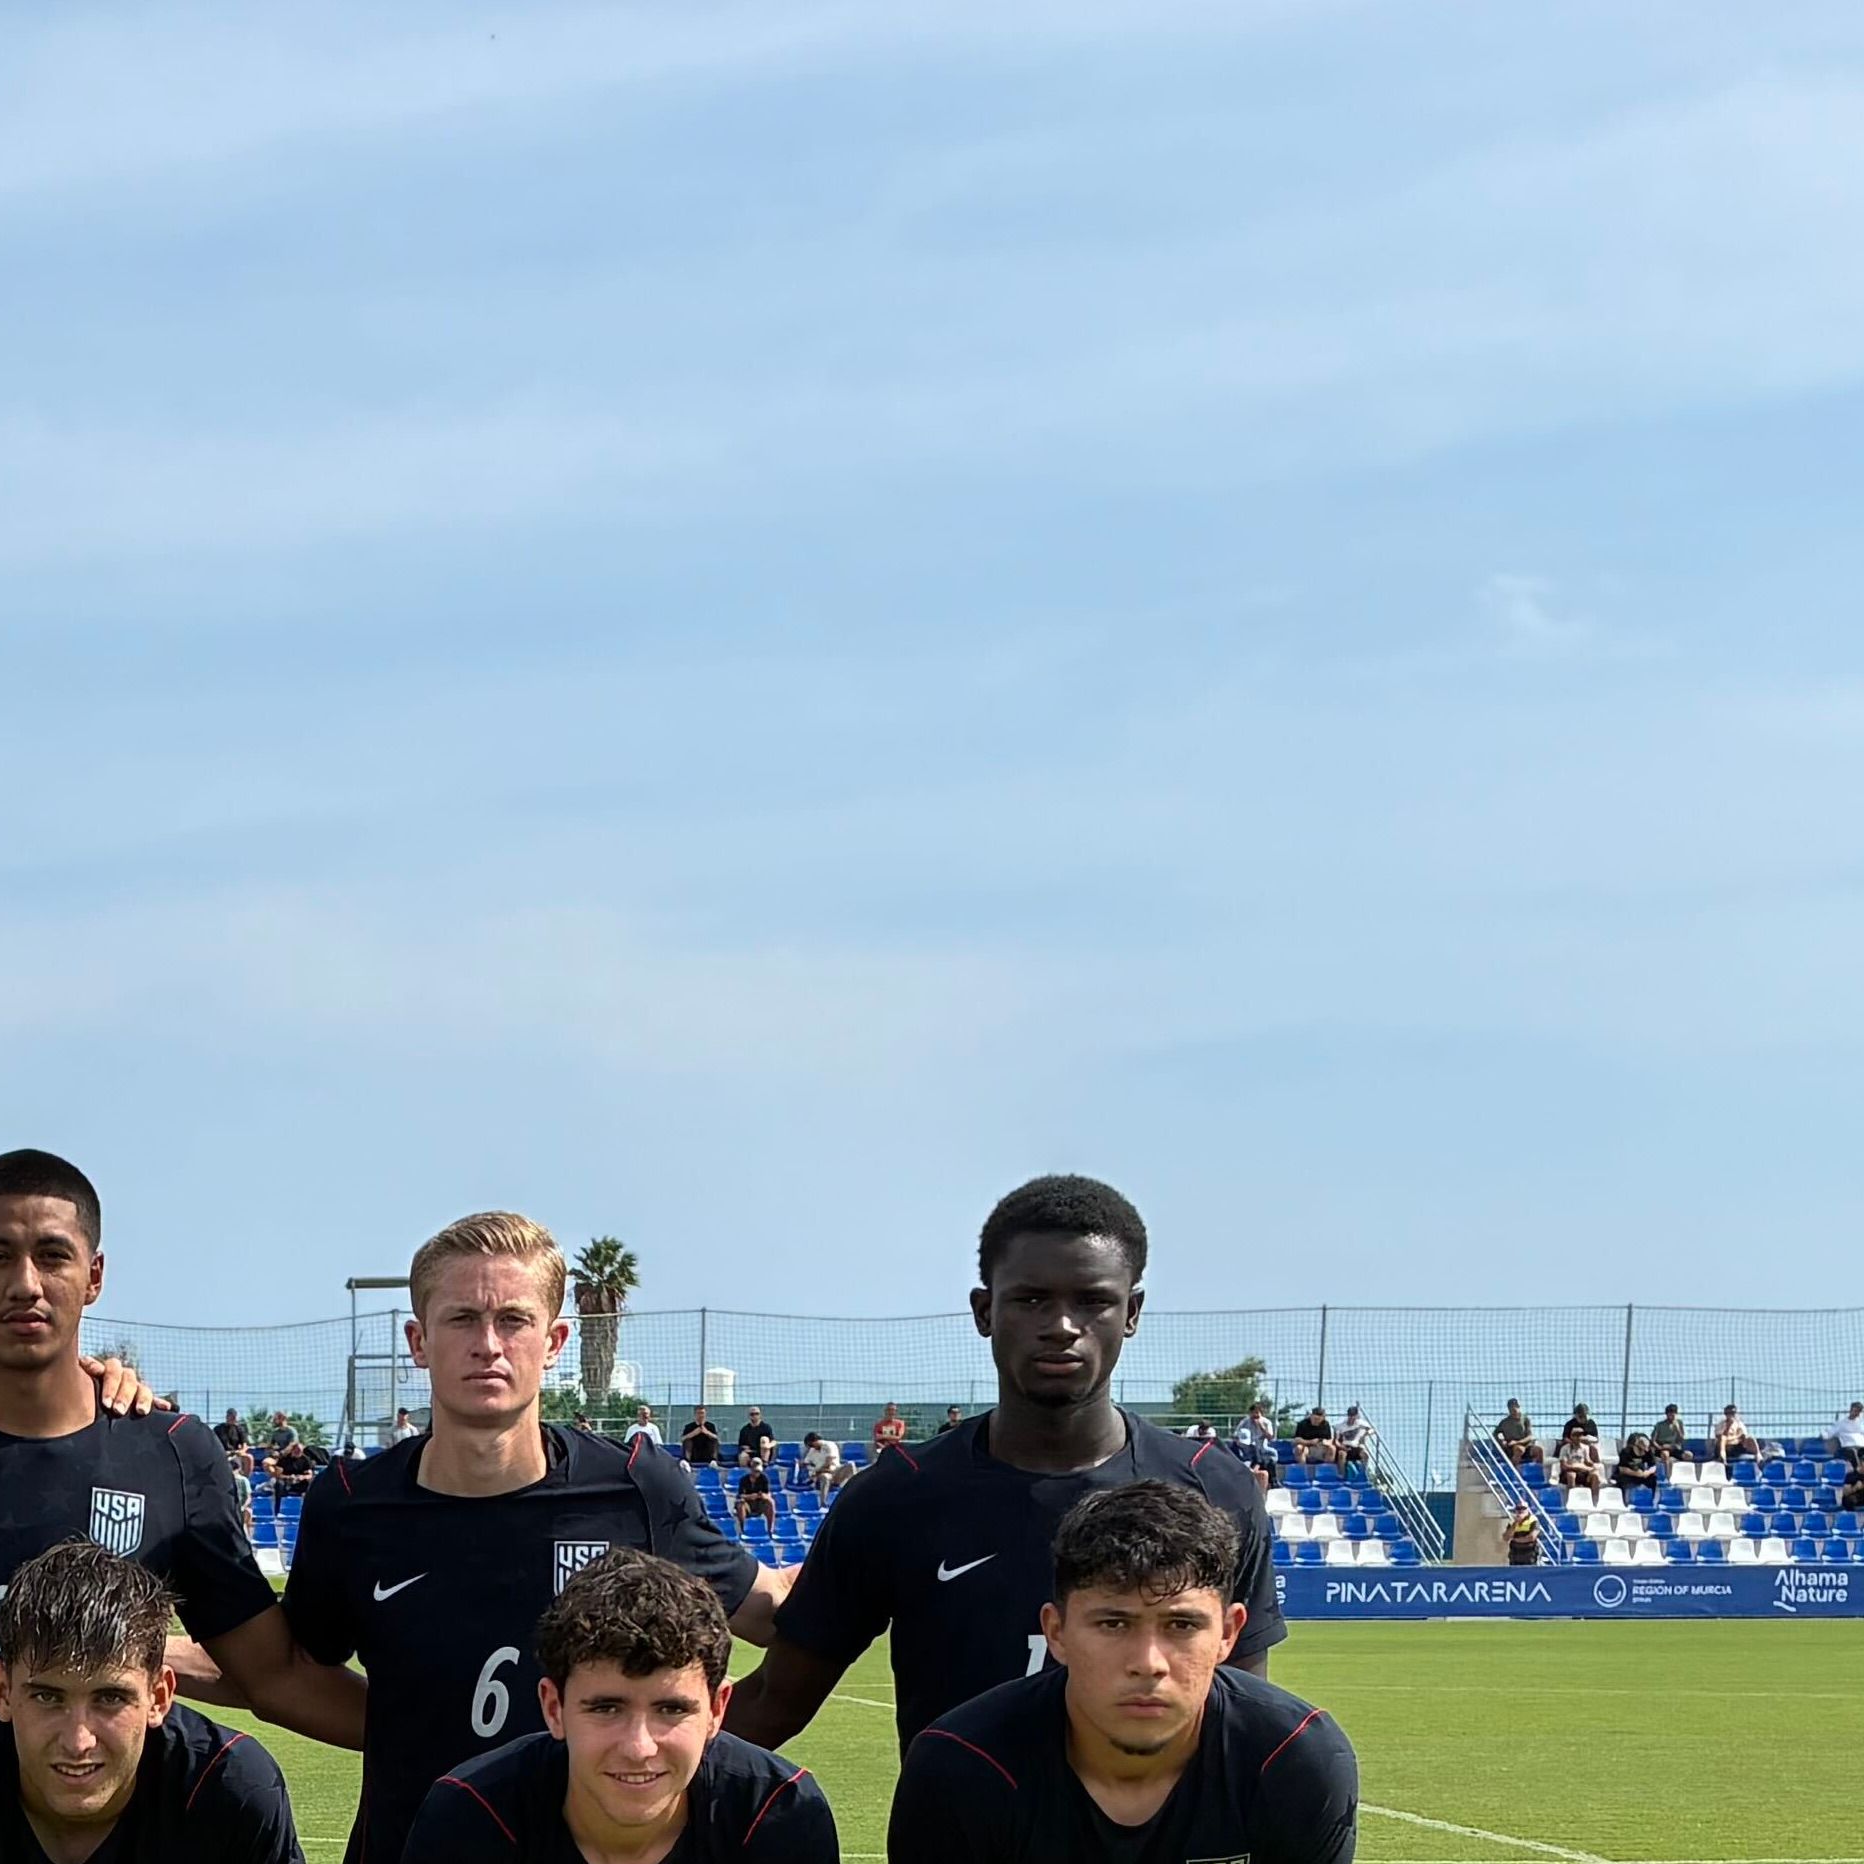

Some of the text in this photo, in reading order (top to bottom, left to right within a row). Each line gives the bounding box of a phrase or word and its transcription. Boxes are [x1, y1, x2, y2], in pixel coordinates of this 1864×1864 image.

[96, 1492, 141, 1521] USA
[1774, 1568, 1849, 1587] Alhama
[1781, 1585, 1848, 1603] Nature
[470, 1645, 521, 1738] 6
